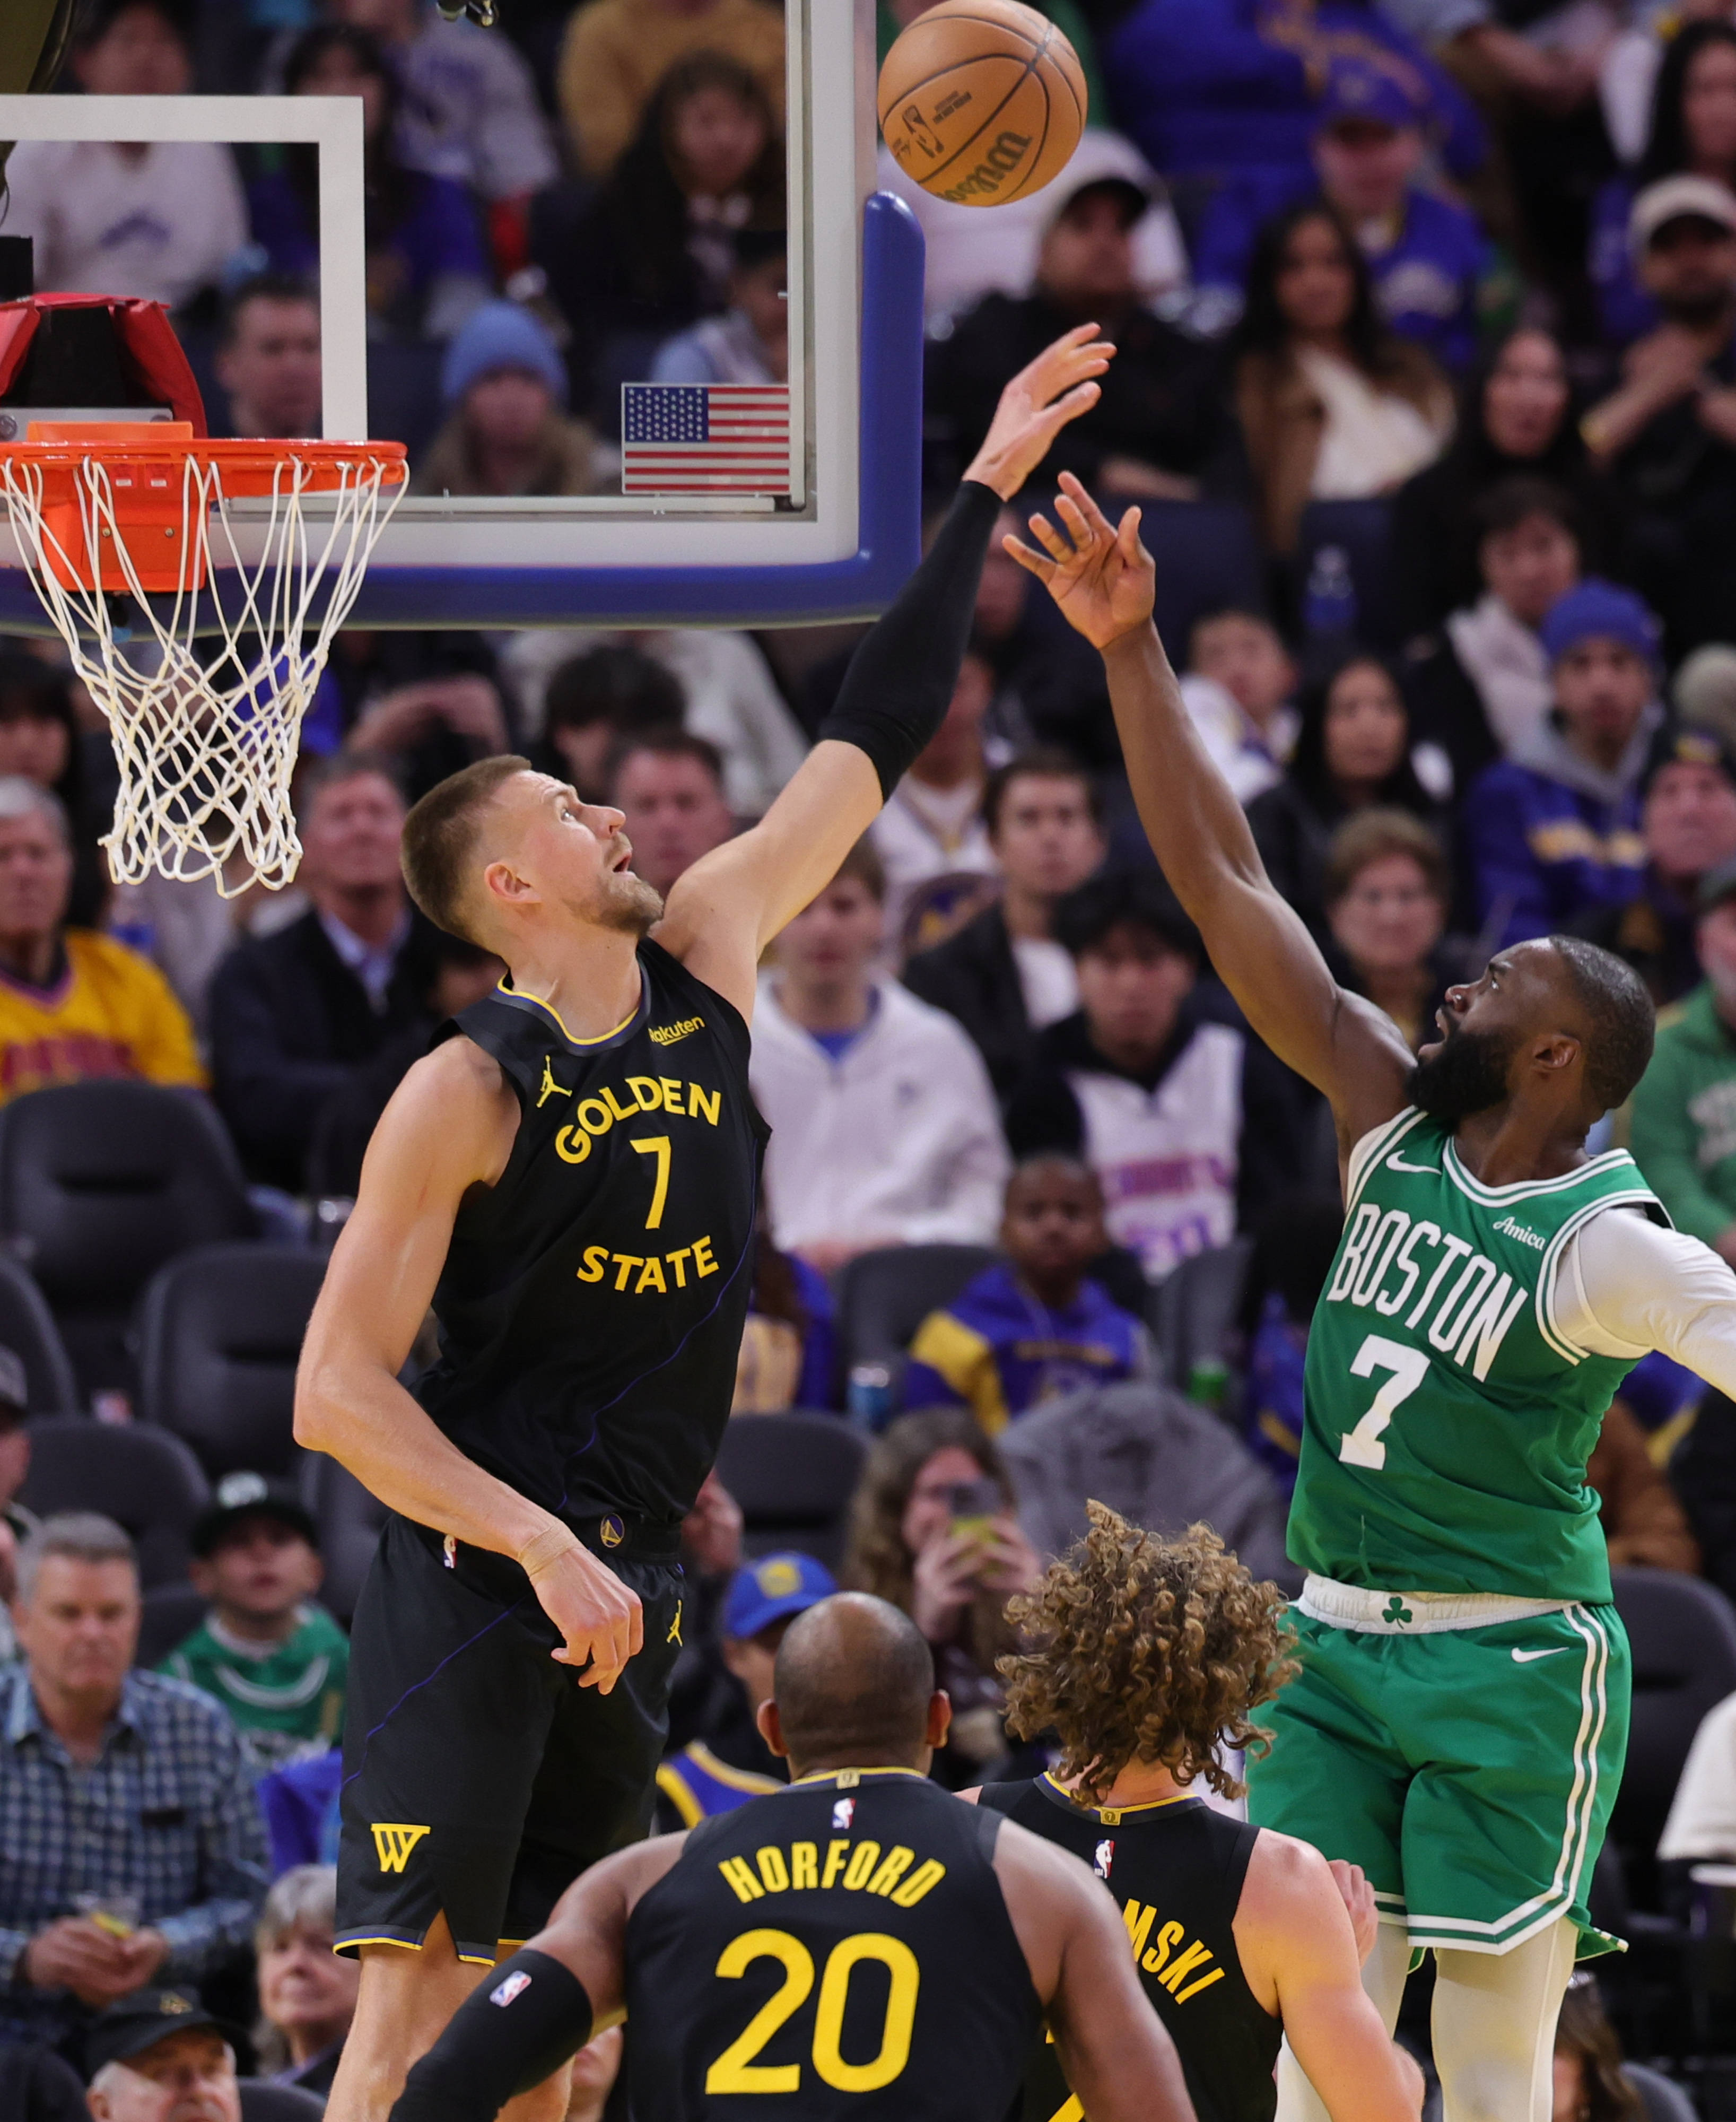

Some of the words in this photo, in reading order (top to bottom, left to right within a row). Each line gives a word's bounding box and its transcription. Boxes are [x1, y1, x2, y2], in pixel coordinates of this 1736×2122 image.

[555, 1076, 721, 1164] GOLDEN
[630, 1136, 671, 1229] 7
[577, 1235, 719, 1294] STATE
[1492, 1216, 1546, 1251] Amica
[1326, 1203, 1529, 1383] BOSTON
[1338, 1334, 1431, 1470] 7
[718, 1839, 946, 1908] HORFORD
[1121, 1898, 1225, 2005] MSKI
[705, 1928, 920, 2094] 20
